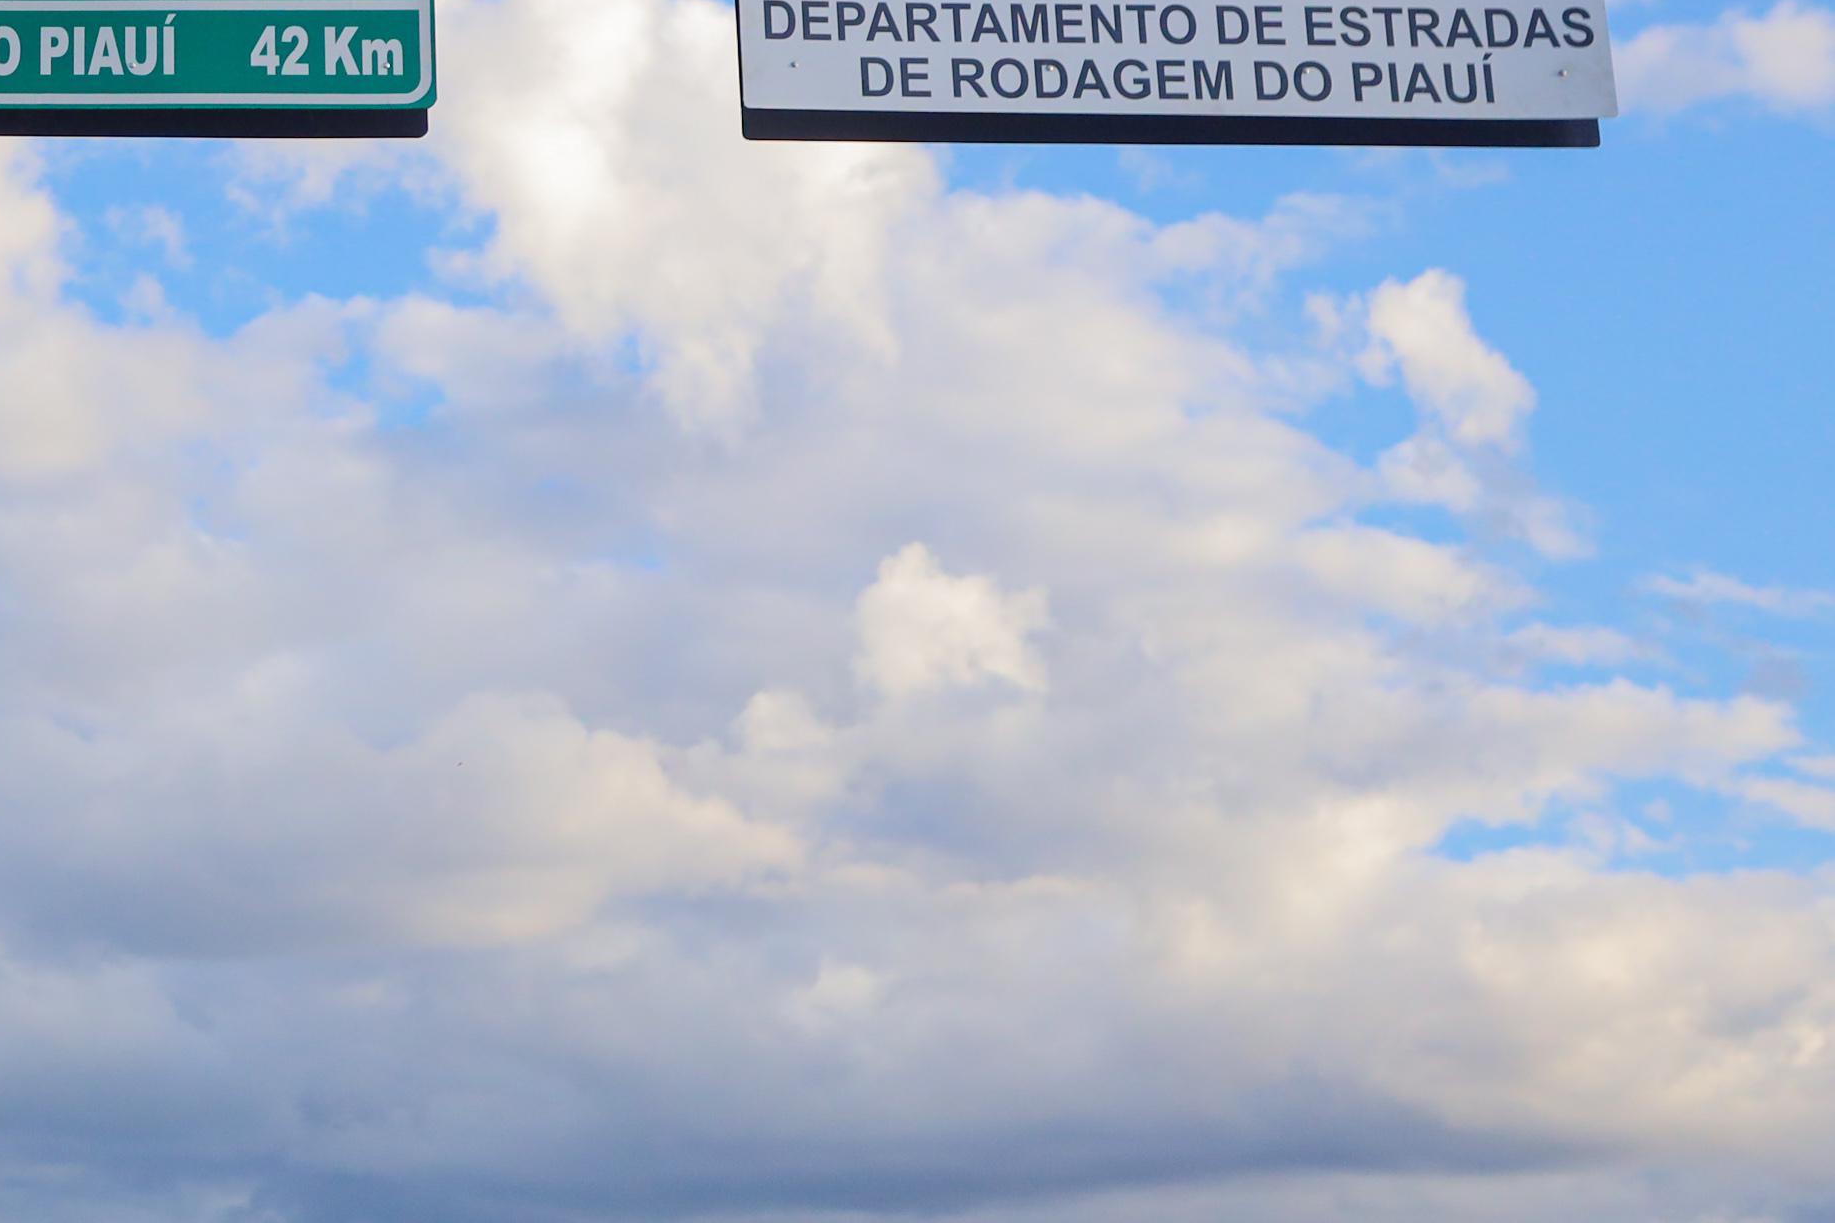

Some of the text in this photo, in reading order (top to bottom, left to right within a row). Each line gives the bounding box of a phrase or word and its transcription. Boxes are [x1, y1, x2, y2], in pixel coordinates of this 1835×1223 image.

[39, 12, 177, 77] PIAUÍ
[250, 26, 309, 77] 42
[324, 27, 405, 77] Km
[763, 0, 1596, 50] DEPARTAMENTO DE ESTRADAS
[860, 52, 1496, 105] DE RODAGEM DO PIAUÍ
